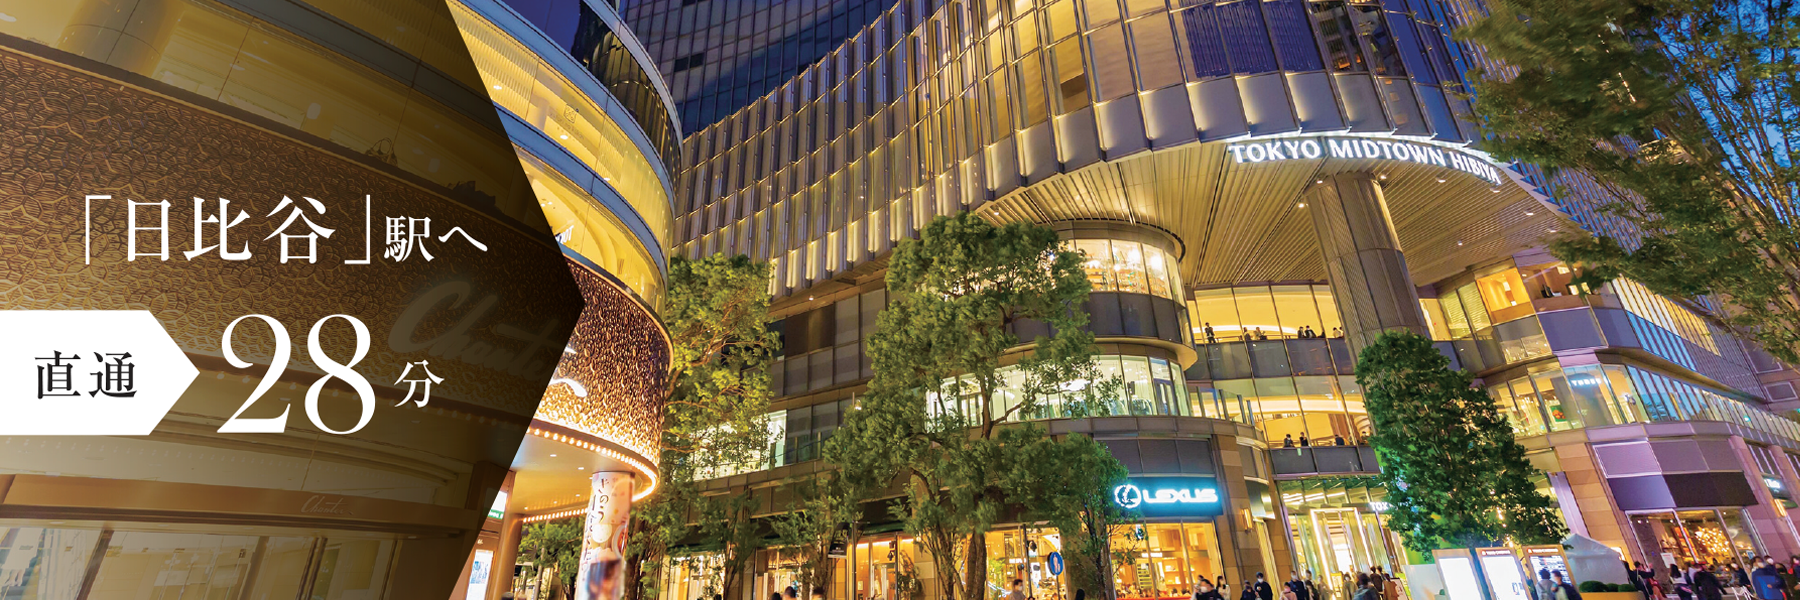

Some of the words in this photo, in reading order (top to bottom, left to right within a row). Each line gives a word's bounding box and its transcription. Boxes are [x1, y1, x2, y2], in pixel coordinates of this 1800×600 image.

[1228, 139, 1322, 164] TOKYO
[1328, 138, 1447, 167] MIDTOWN
[1448, 150, 1502, 186] HIBIYA
[1142, 488, 1219, 503] LEXUS
